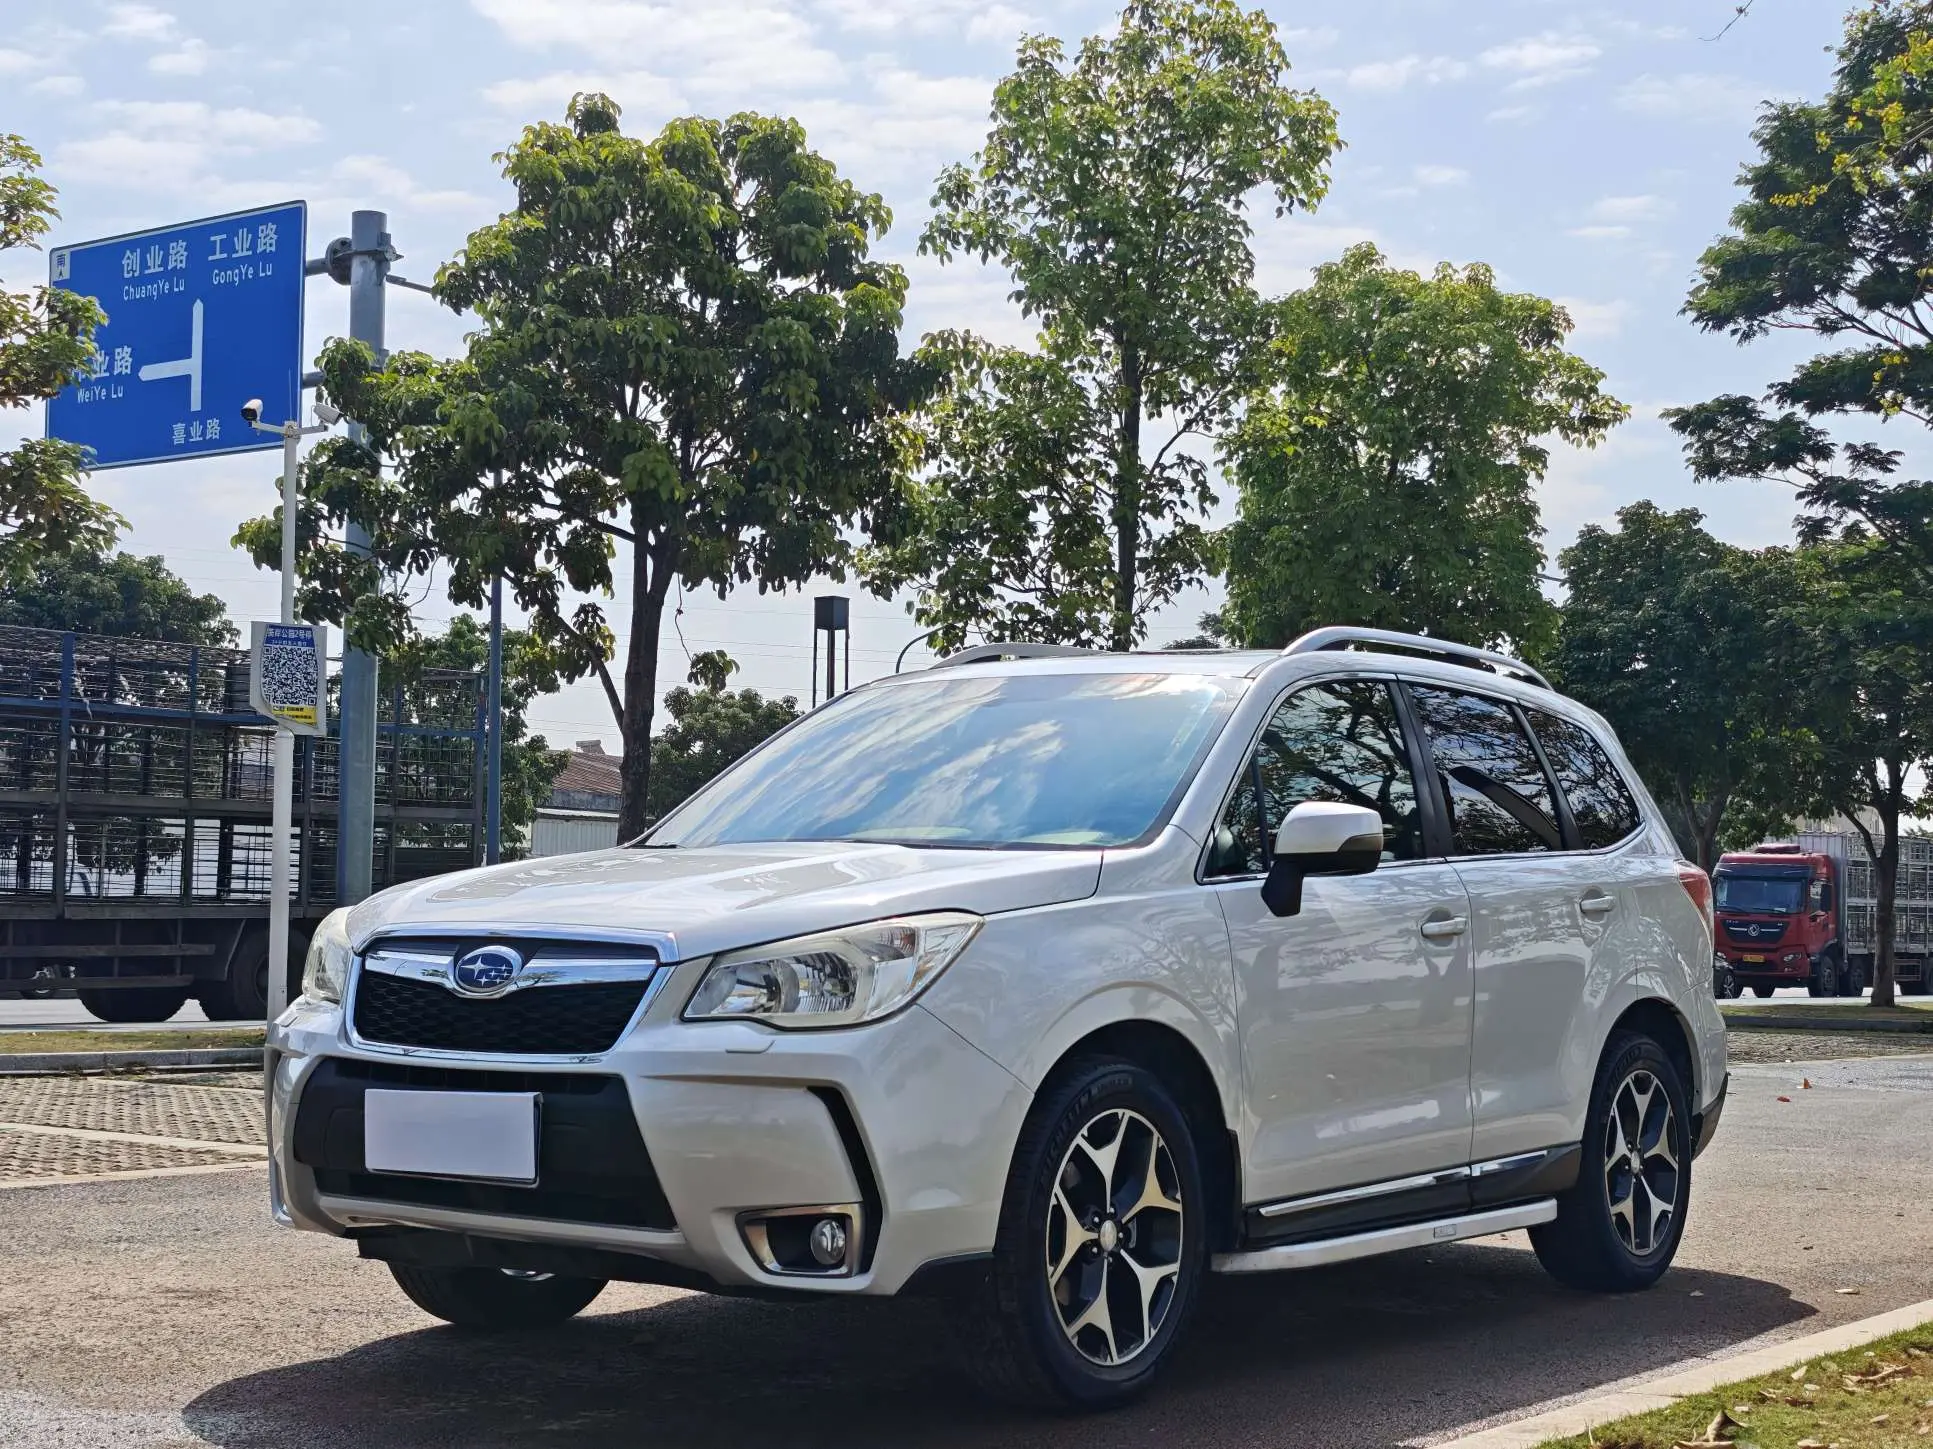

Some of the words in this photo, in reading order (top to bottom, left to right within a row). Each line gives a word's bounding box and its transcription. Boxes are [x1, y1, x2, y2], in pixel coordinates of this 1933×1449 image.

[208, 222, 278, 261] 工业路
[122, 239, 188, 278] 创业路
[212, 264, 254, 286] GongYe
[259, 261, 273, 277] Lu
[123, 278, 169, 301] ChuangYe
[174, 277, 185, 292] Lu
[72, 345, 133, 382] 业路
[77, 384, 107, 403] WeiYe
[111, 383, 124, 399] Lu
[172, 417, 221, 446] 喜业路
